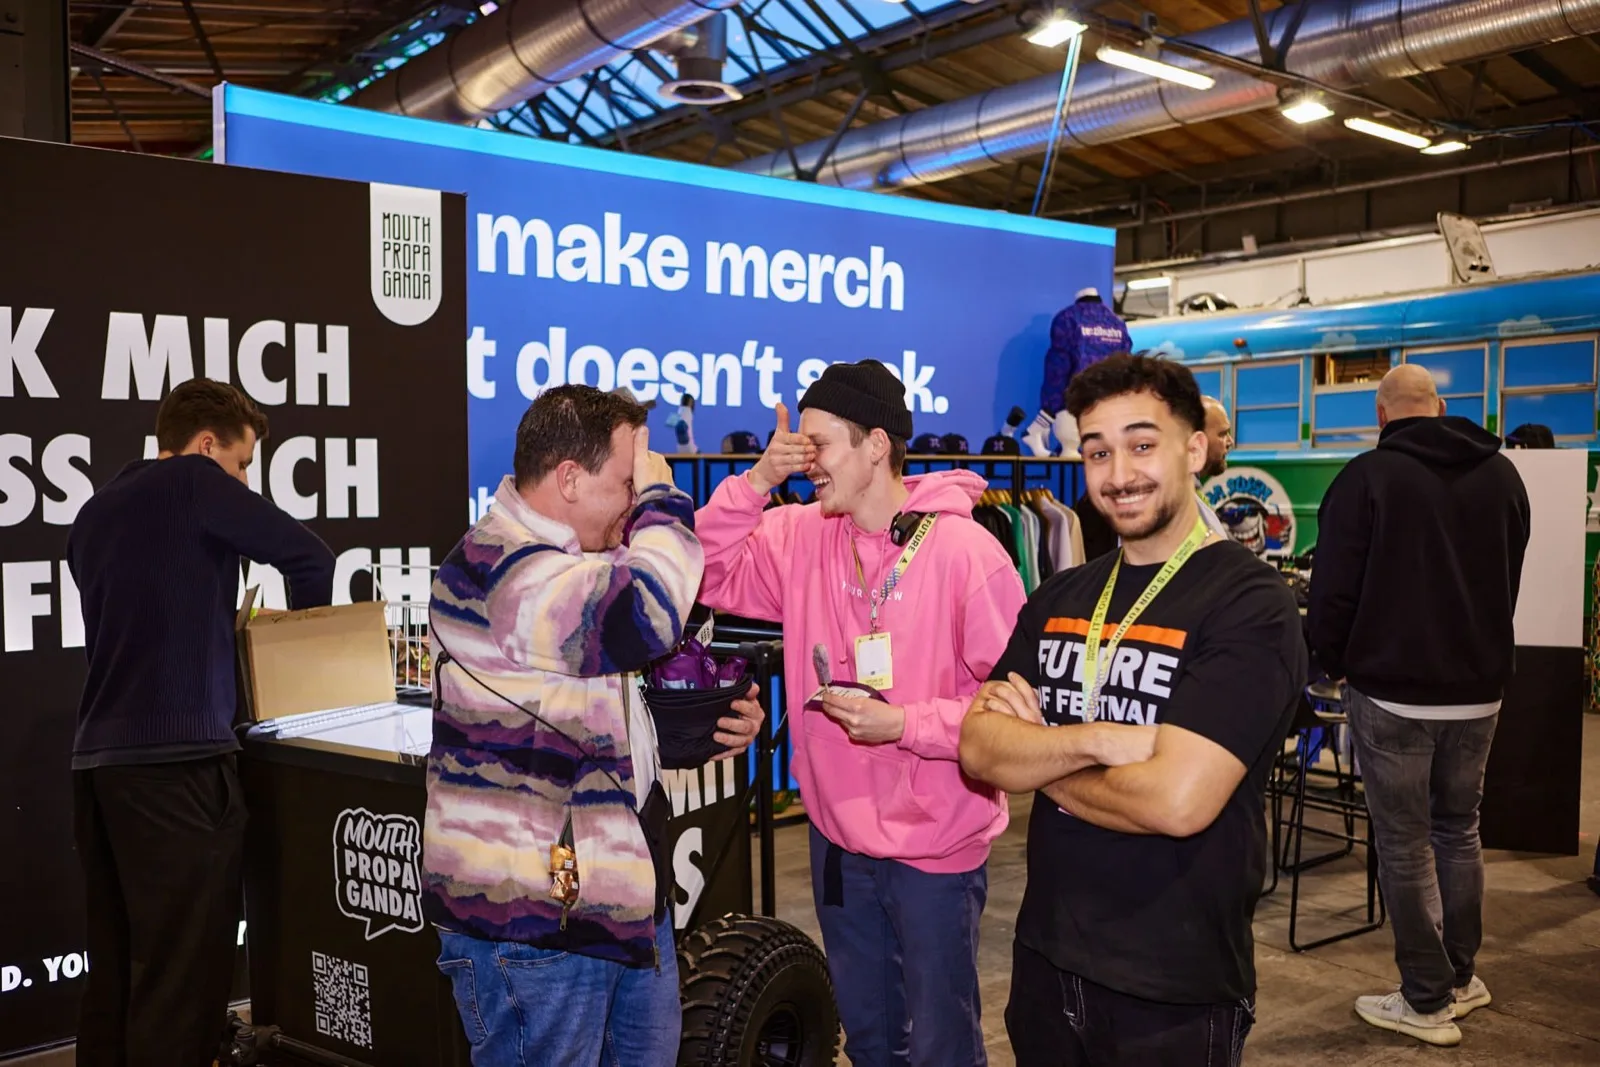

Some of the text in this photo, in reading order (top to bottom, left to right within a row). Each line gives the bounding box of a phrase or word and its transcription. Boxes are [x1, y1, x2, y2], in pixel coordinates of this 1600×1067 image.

[382, 212, 430, 243] MOUTH
[383, 241, 430, 272] PROPA
[477, 211, 904, 311] make merch
[383, 270, 430, 300] GANDA
[101, 311, 350, 407] MICH
[796, 350, 949, 415] sk.
[907, 519, 932, 553] FUTURE
[1156, 564, 1175, 583] IT'S
[1140, 584, 1158, 606] OUR
[1038, 639, 1179, 699] FUTRE
[1056, 688, 1157, 726] FETIVAL
[343, 815, 415, 861] MOUTH
[344, 848, 417, 891] PROPA
[346, 879, 418, 922] GANDA
